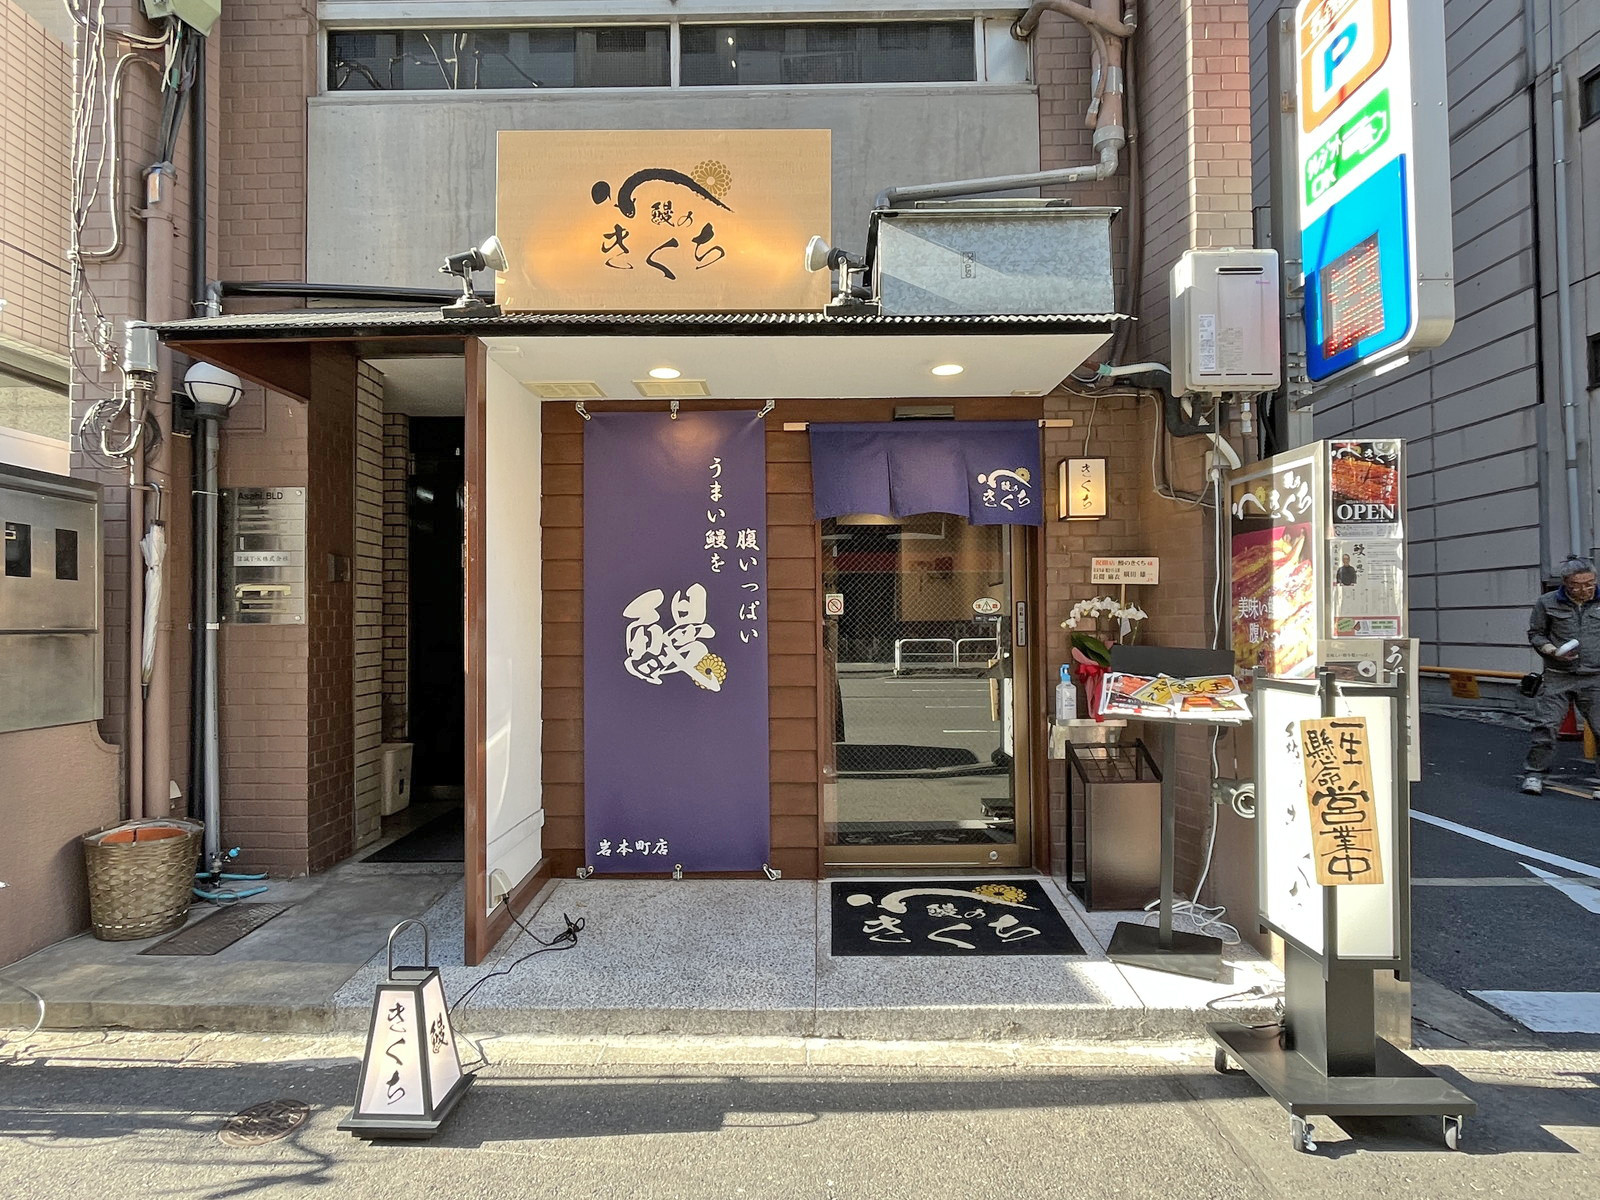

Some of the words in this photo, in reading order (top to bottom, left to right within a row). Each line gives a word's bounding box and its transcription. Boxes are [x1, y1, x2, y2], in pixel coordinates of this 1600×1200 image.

[1323, 22, 1358, 92] P
[650, 200, 694, 227] 鰻の
[601, 222, 726, 280] きくち
[266, 491, 283, 500] BLD
[982, 488, 1031, 511] きくち
[1080, 463, 1093, 510] きくち
[704, 456, 729, 573] うまい鰻を
[1336, 503, 1396, 520] OPEN
[736, 528, 760, 644] 腹いっぱい
[1330, 720, 1365, 766] 一生
[595, 838, 670, 857] 岩本町店
[1311, 780, 1374, 882] 営業中
[862, 913, 1042, 951] きくち
[385, 1002, 407, 1106] きくち
